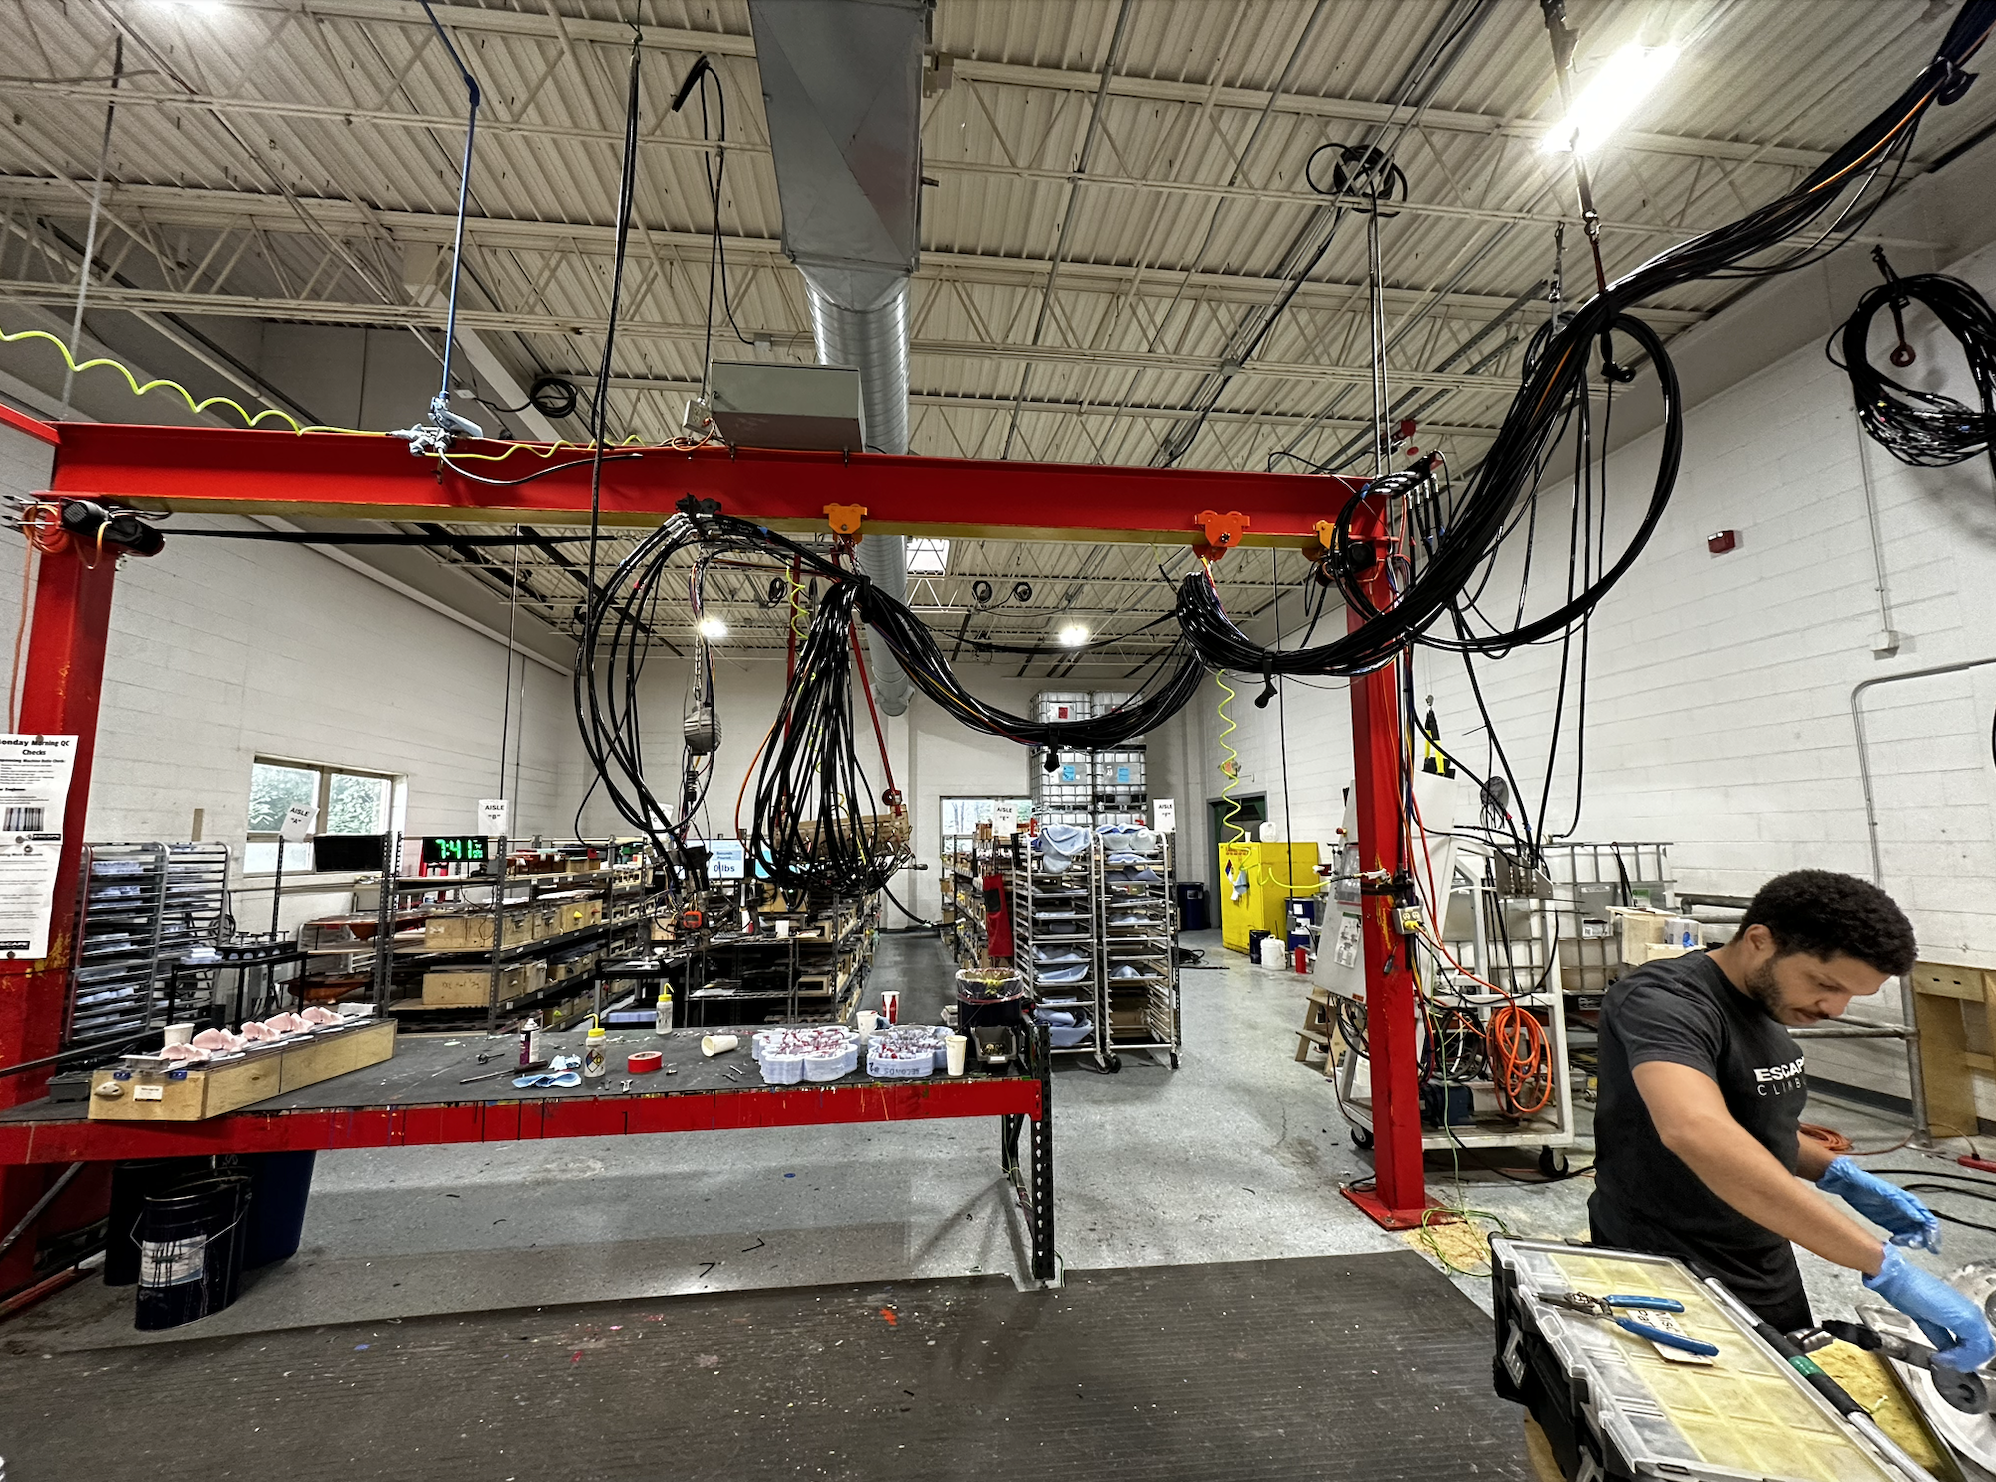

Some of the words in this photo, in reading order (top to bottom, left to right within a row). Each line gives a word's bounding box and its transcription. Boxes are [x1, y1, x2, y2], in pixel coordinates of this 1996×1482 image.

[0, 739, 29, 747] onday
[290, 807, 310, 818] AISLE
[435, 839, 473, 860] 7:41
[721, 864, 735, 872] lbs
[1753, 1056, 1805, 1082] ESCAP
[1757, 1077, 1806, 1096] CLIMB
